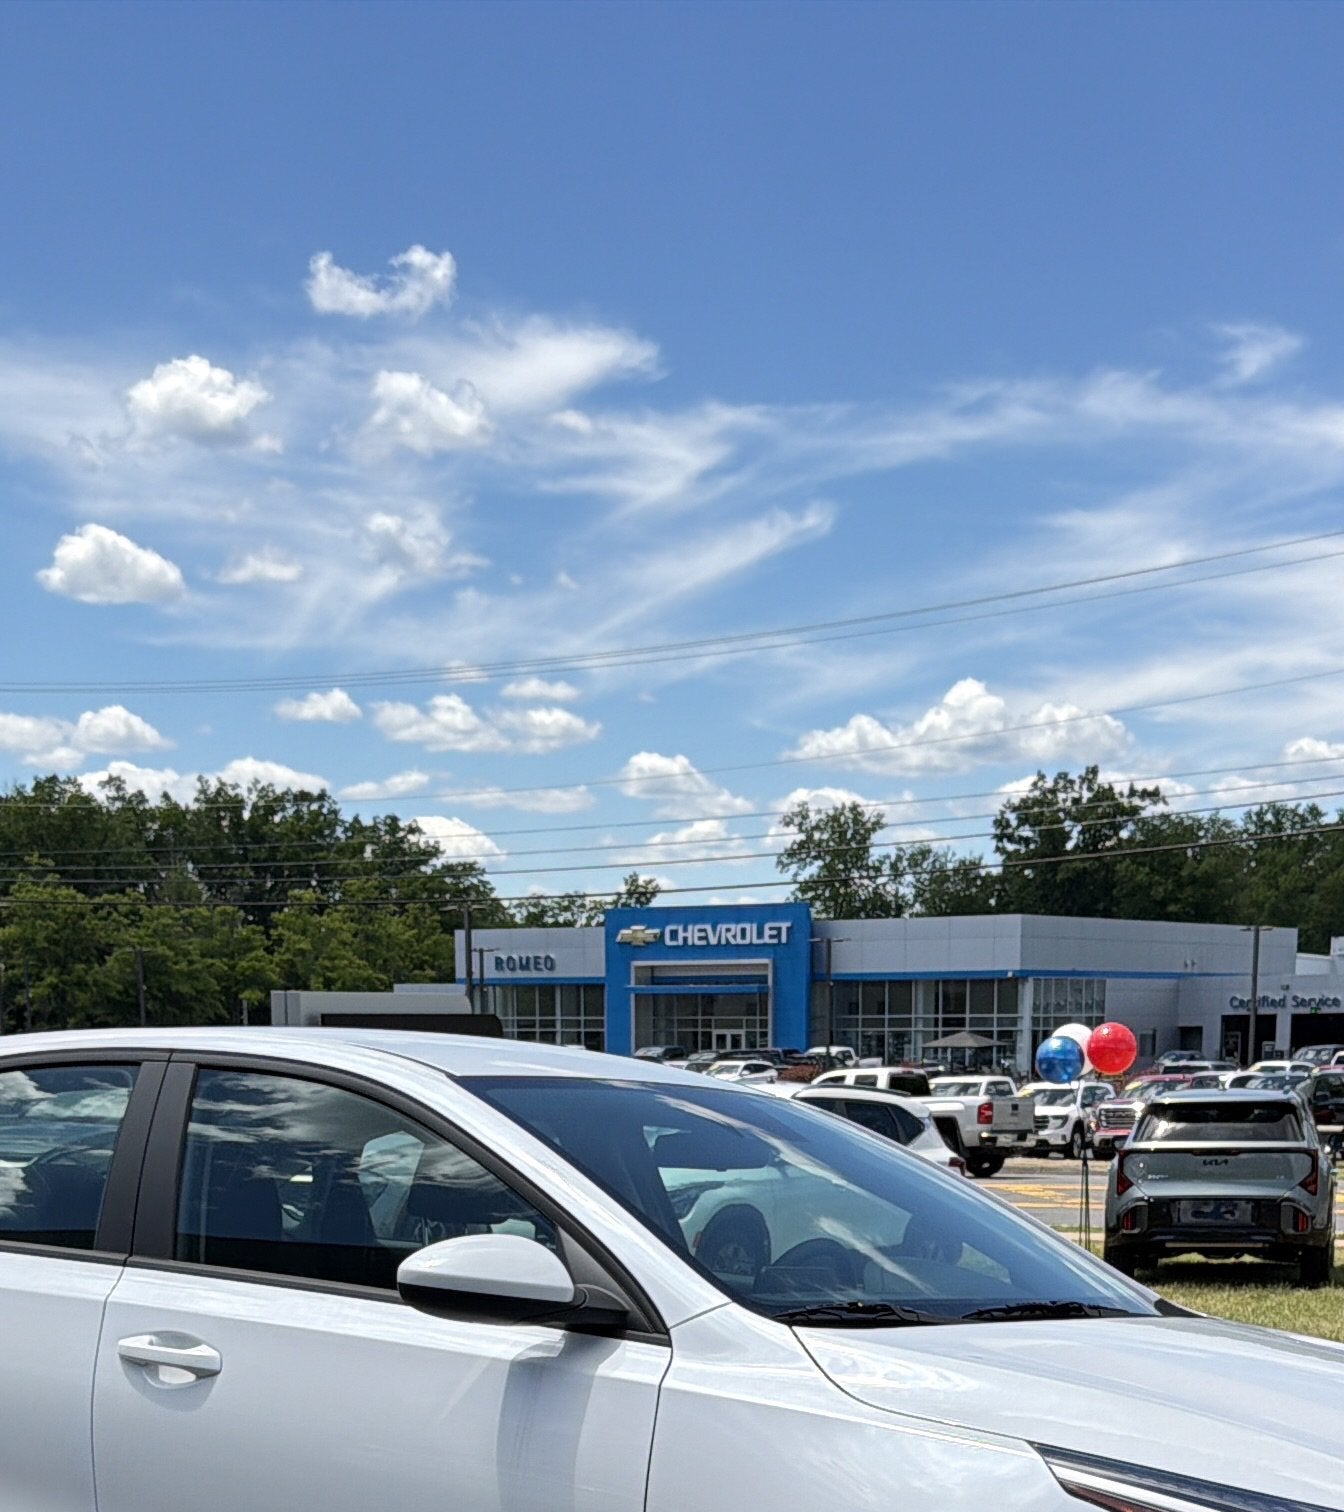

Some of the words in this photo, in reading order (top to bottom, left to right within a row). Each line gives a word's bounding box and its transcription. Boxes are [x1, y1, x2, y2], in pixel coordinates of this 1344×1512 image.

[664, 921, 792, 946] CHEVROLET
[494, 954, 556, 972] ROMEO
[1229, 995, 1286, 1010] Cerified
[1291, 994, 1341, 1008] Service
